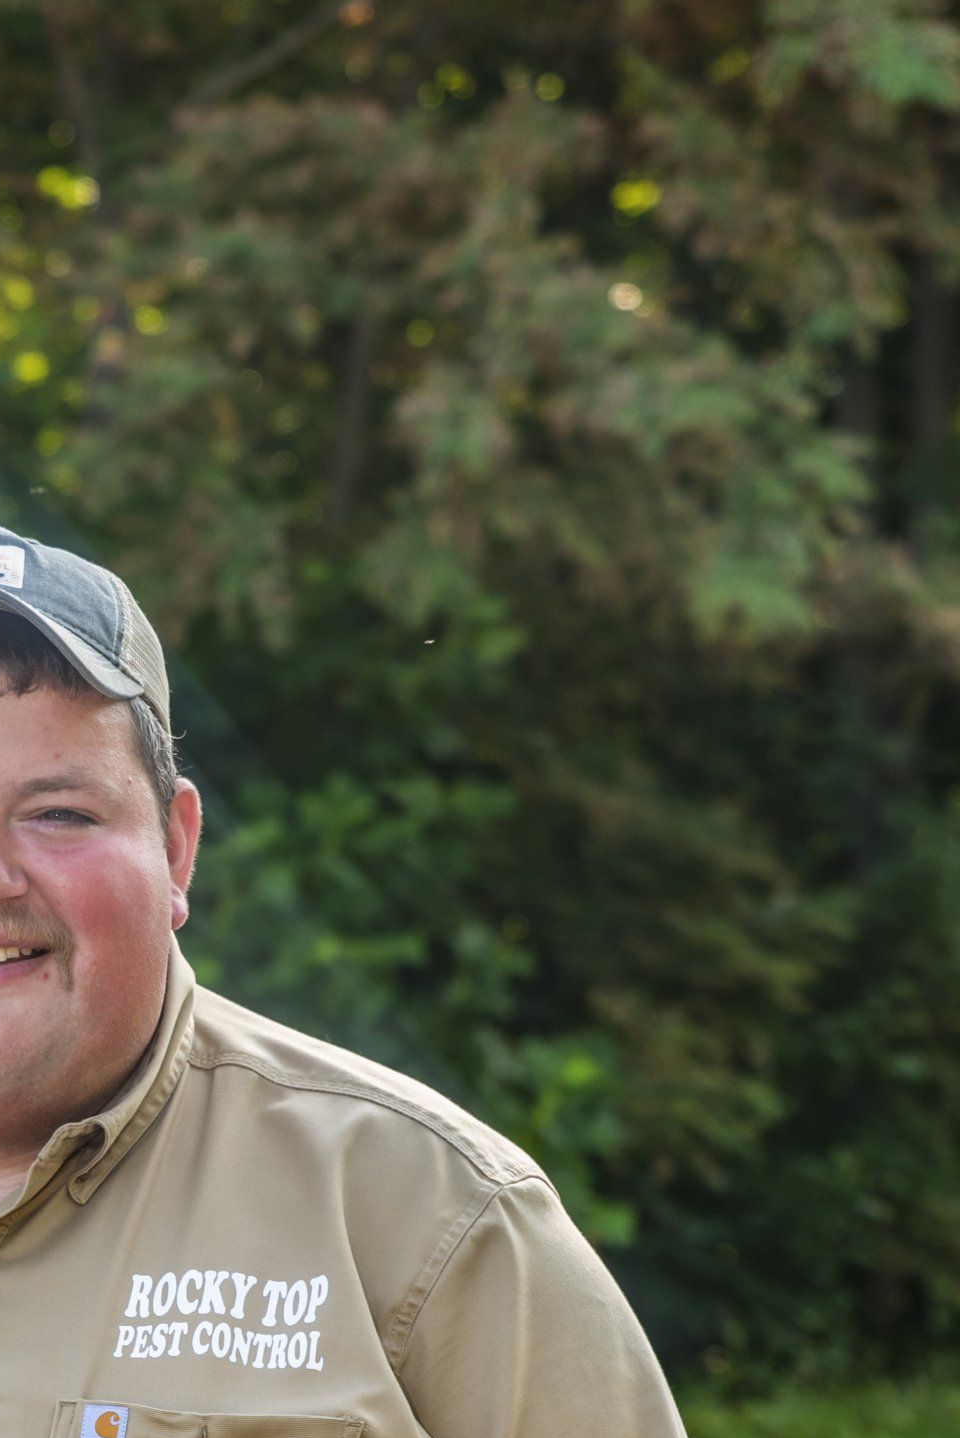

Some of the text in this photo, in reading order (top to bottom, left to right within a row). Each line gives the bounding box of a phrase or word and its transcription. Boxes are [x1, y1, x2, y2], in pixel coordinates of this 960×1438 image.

[124, 1268, 329, 1327] ROCKY TOP
[112, 1320, 324, 1372] PEST CONTROL
